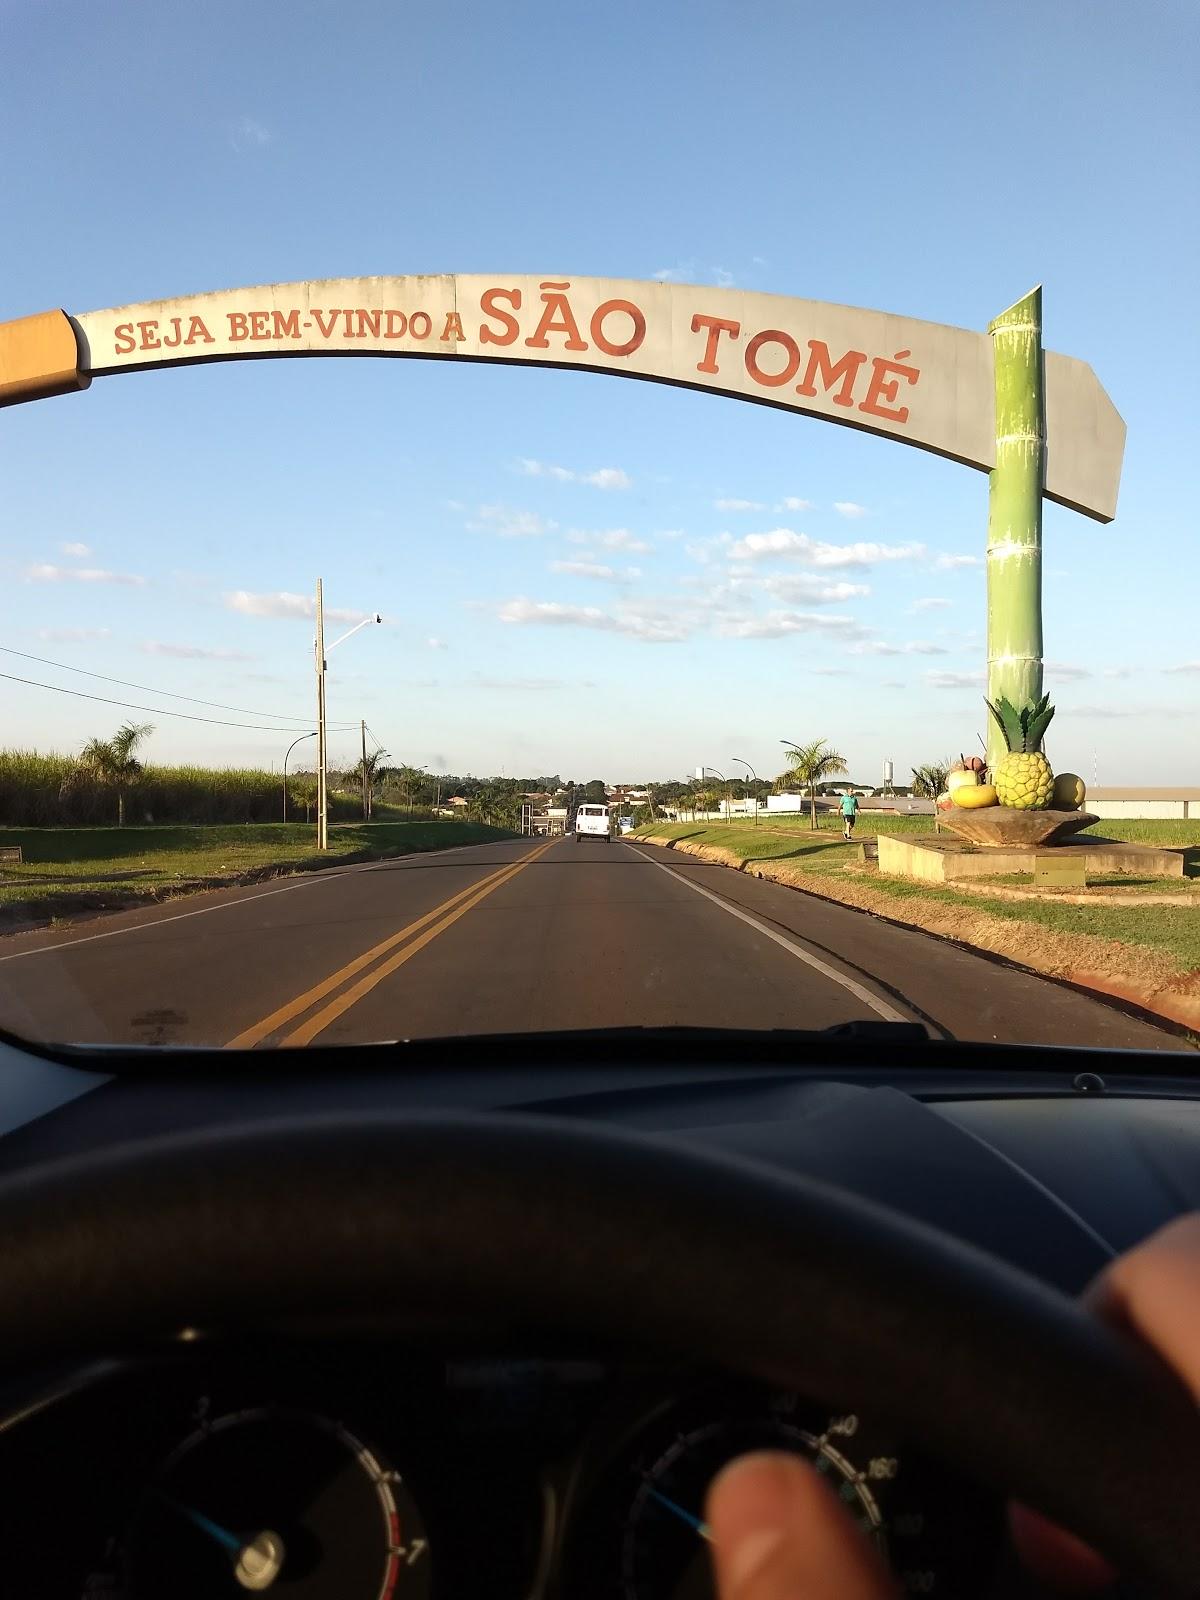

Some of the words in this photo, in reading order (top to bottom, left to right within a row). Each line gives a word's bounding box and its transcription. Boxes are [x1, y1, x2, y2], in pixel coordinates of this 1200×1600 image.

[114, 315, 216, 354] SEJA
[226, 309, 433, 341] BEM-VINDO
[440, 312, 466, 341] A
[479, 282, 646, 357] SÃO
[691, 314, 920, 423] TOMÉ
